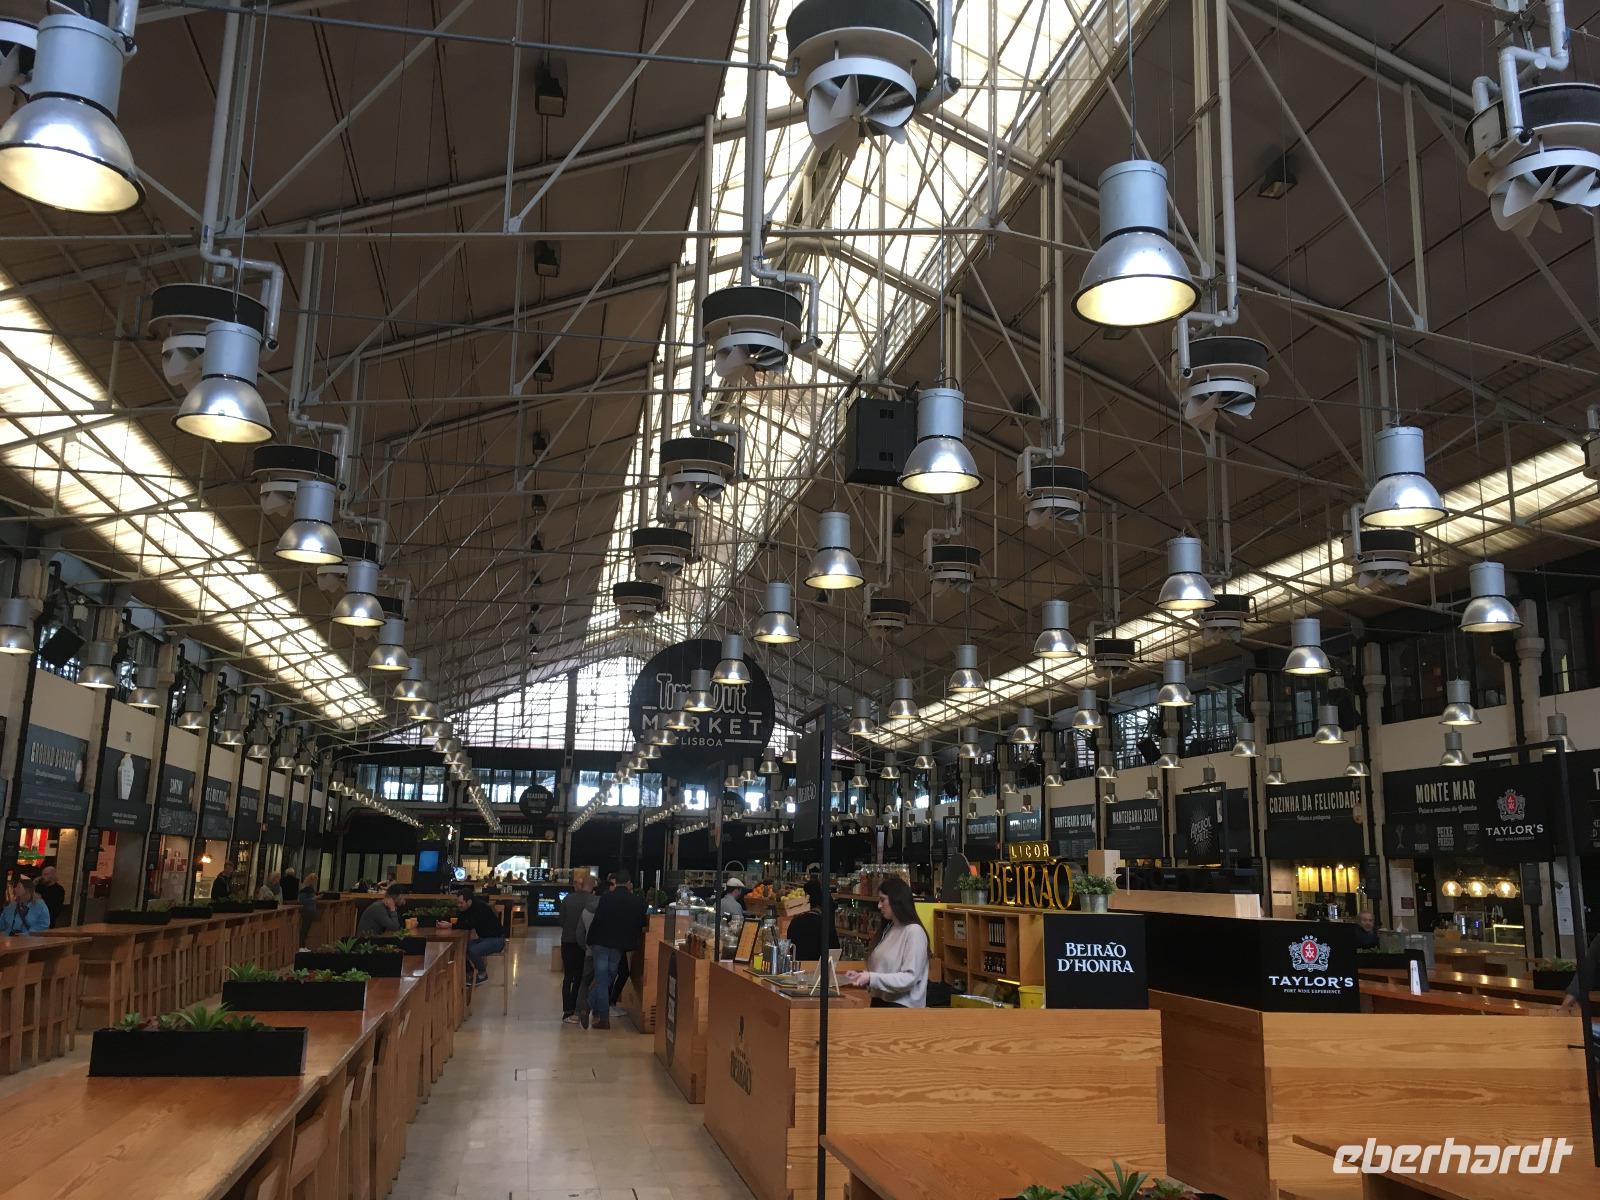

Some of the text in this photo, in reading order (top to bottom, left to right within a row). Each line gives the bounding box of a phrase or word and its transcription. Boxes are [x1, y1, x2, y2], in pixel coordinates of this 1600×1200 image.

[641, 713, 763, 736] MRKET
[680, 736, 723, 748] LISBOA
[1415, 779, 1476, 804] MONTE MAR
[1269, 790, 1361, 814] COZINHA DA FELICIDADE
[1112, 807, 1158, 825] MANTEIGARIA SILVA
[1485, 823, 1544, 836] TAYLOR'S
[1011, 843, 1050, 858] LICOR
[988, 858, 1074, 911] BEIRÃO
[1065, 941, 1127, 958] BEIRÃO
[1057, 958, 1135, 974] D'HONRA
[1268, 975, 1354, 989] TAYLOR'S
